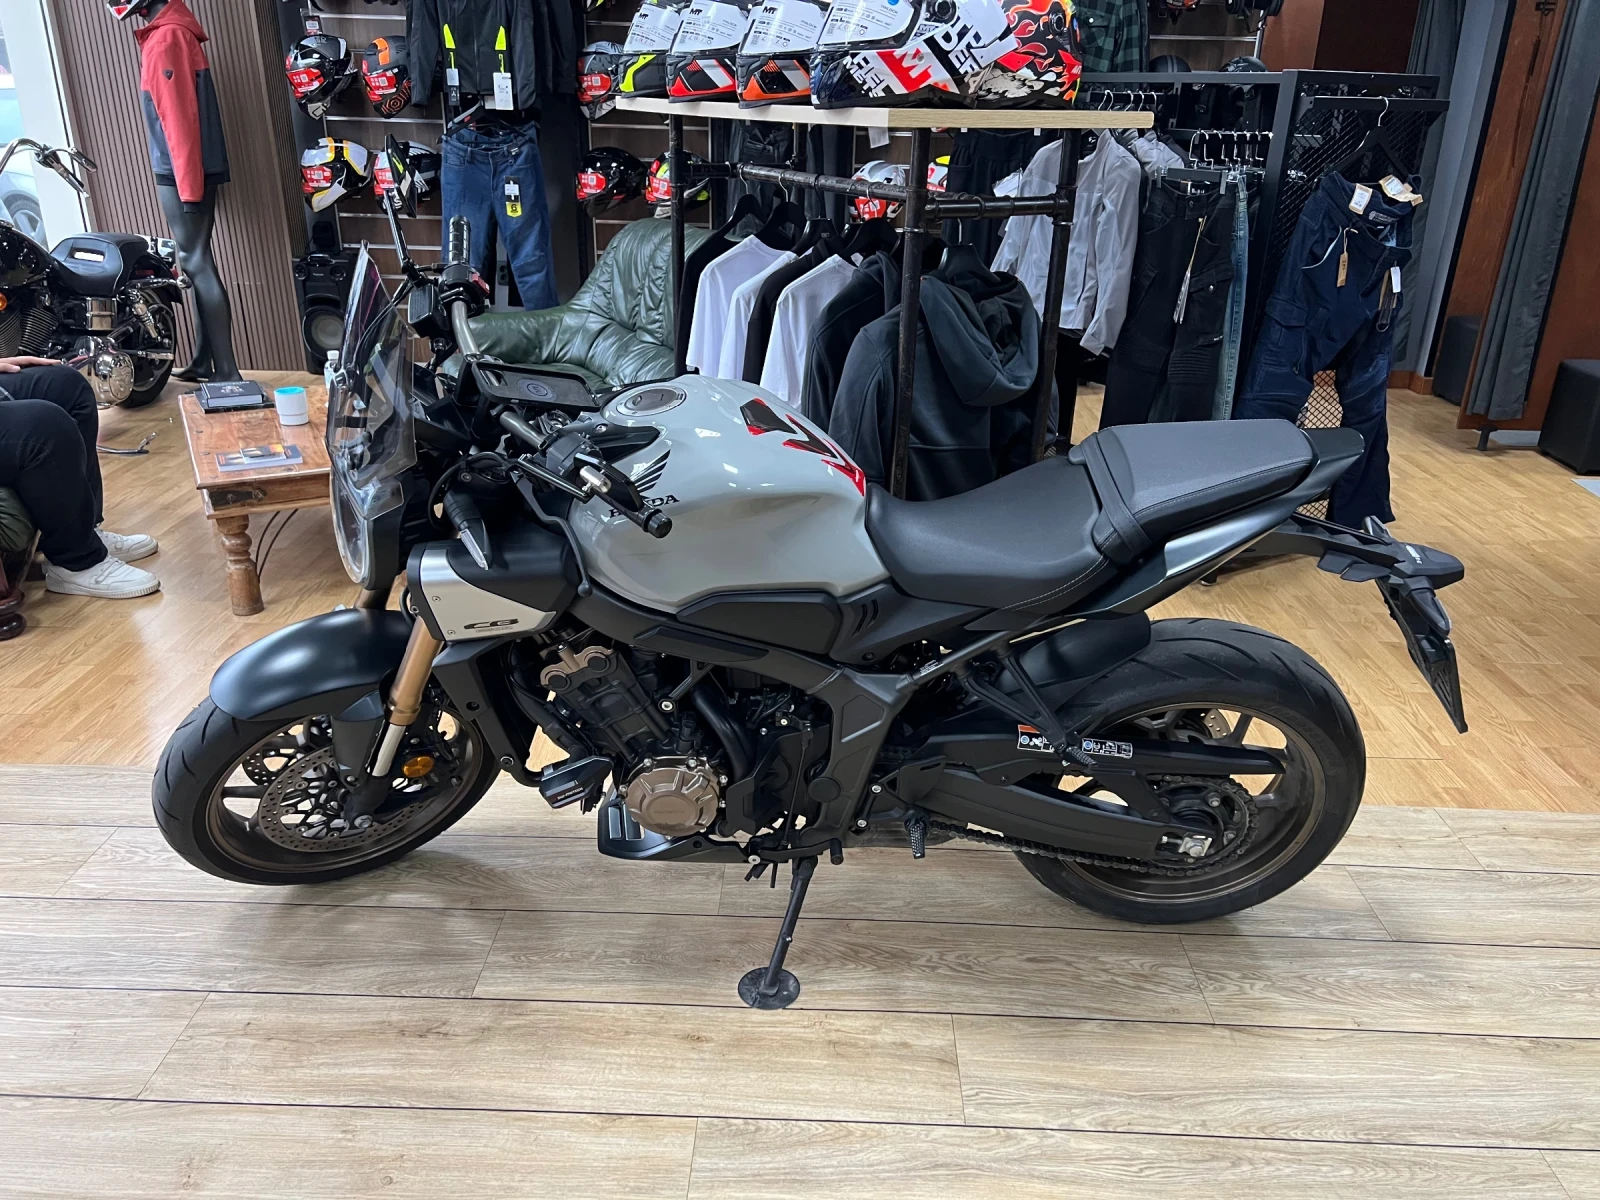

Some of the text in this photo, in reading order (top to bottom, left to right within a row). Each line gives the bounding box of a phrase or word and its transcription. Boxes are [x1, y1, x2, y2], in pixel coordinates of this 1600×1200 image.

[689, 8, 703, 16] MT
[762, 6, 778, 15] MT
[609, 494, 680, 518] HDA
